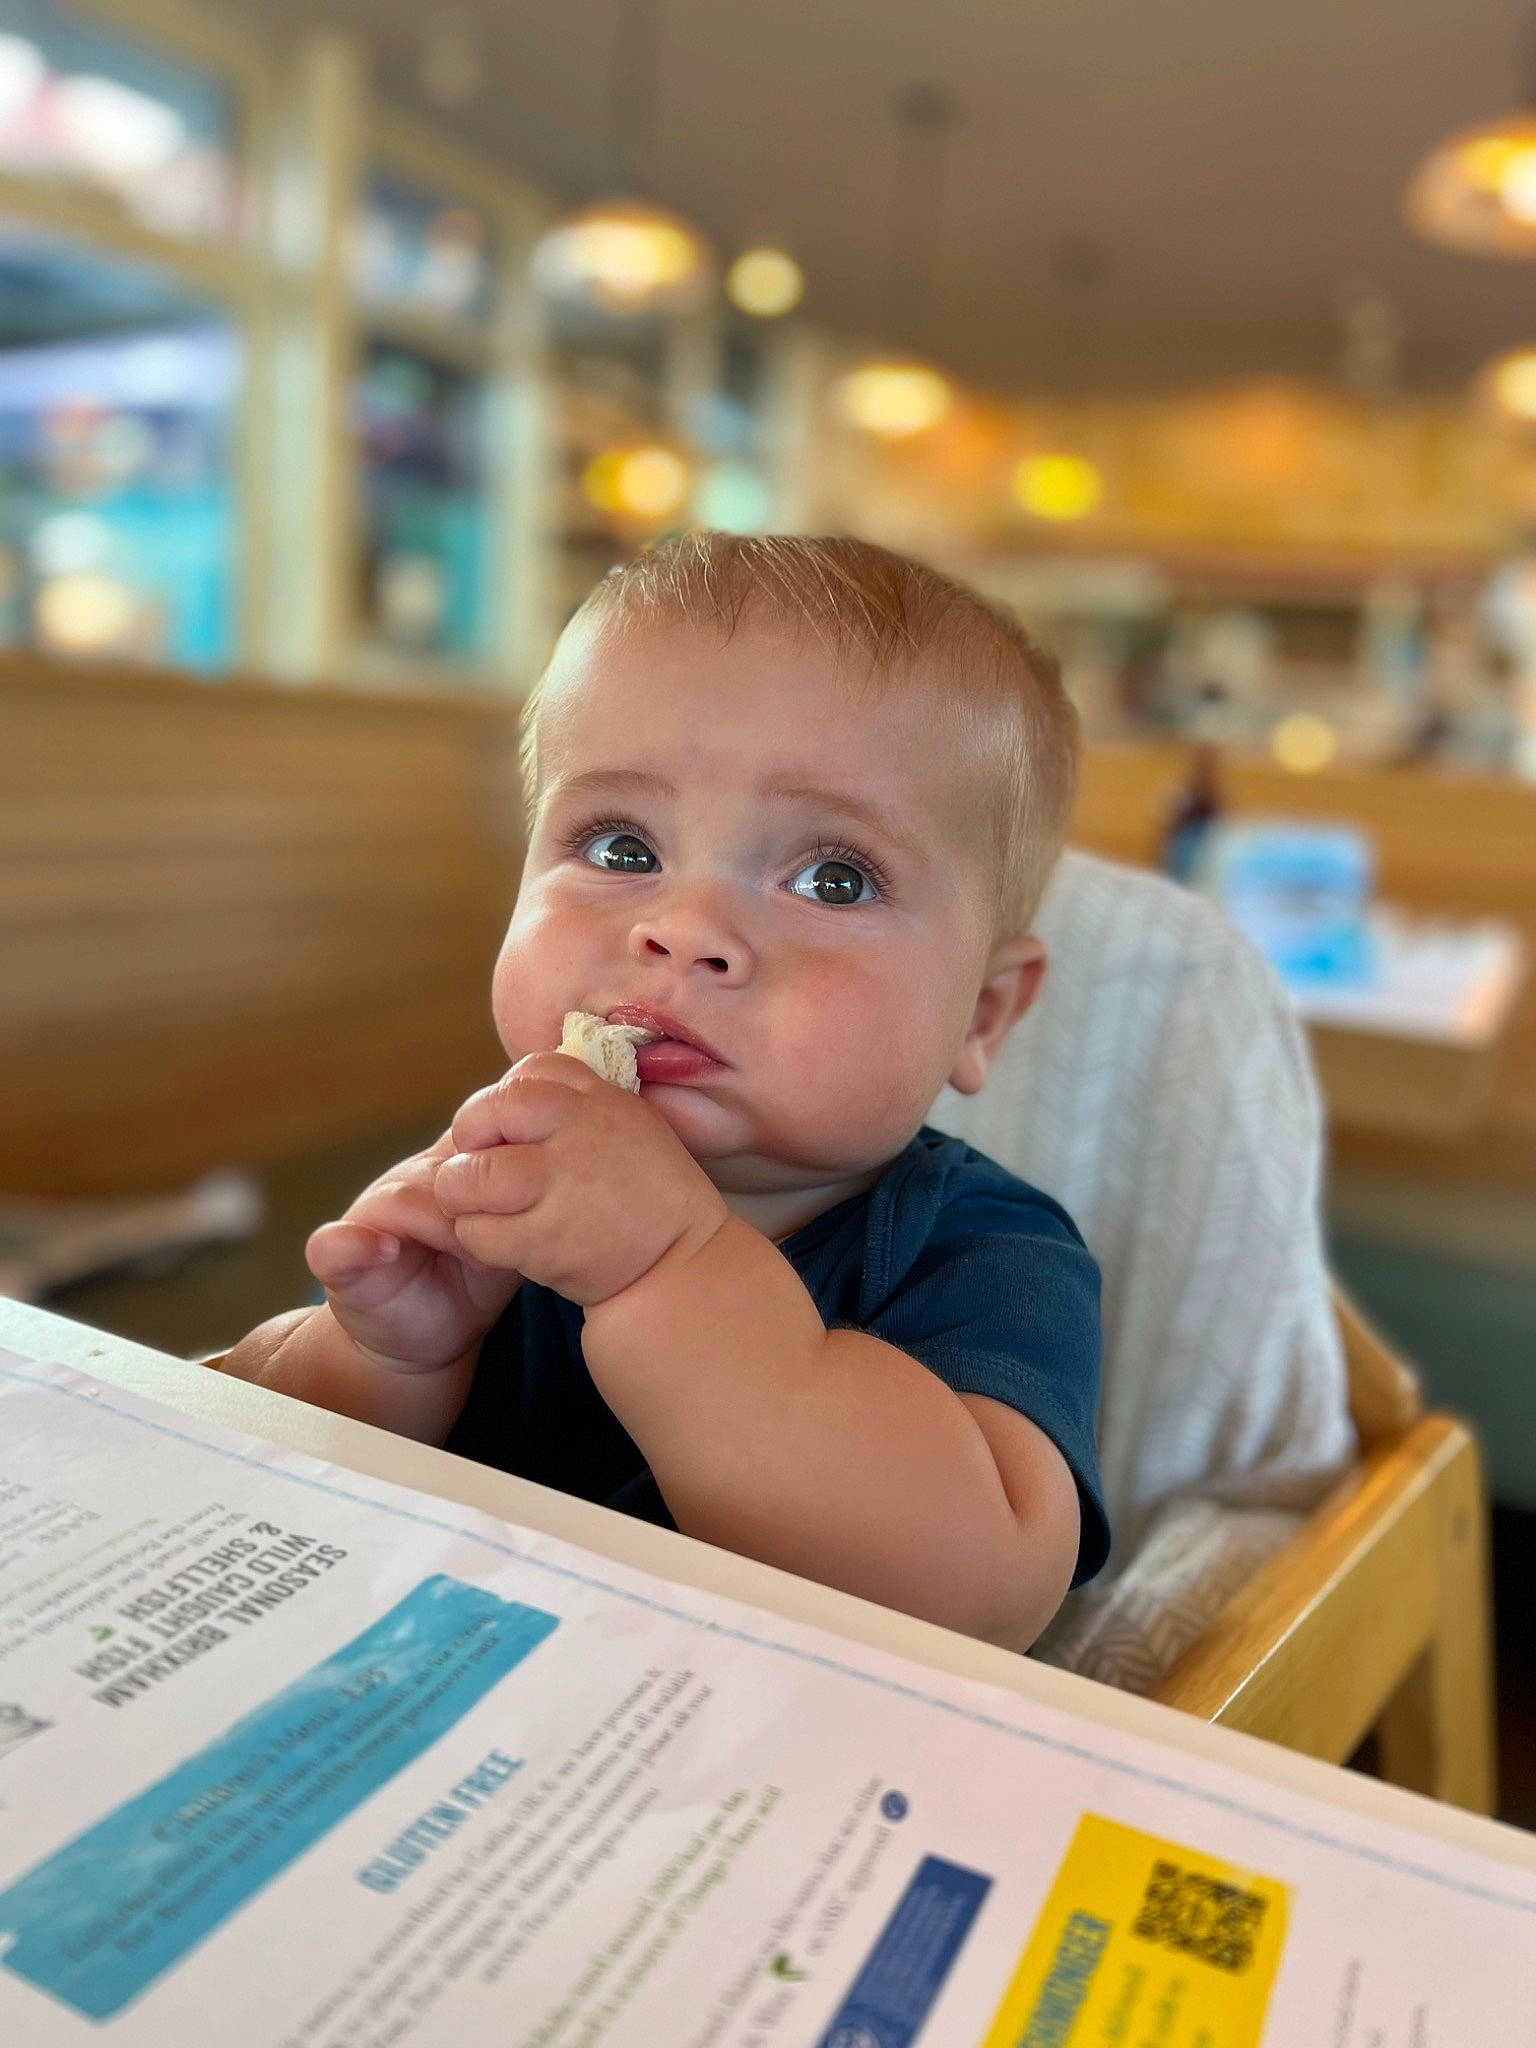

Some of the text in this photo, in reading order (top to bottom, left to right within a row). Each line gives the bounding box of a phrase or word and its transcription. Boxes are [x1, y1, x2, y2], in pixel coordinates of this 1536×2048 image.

[246, 1533, 318, 1576] WILD
[248, 1521, 282, 1537] &
[117, 1537, 258, 1623] SHELLFISH
[147, 1573, 256, 1640] CAUGHT
[219, 1543, 348, 1626] SEASONAL
[72, 1634, 154, 1682] FISH
[356, 1799, 467, 1895] GLUTEN
[449, 1748, 525, 1811] FREE
